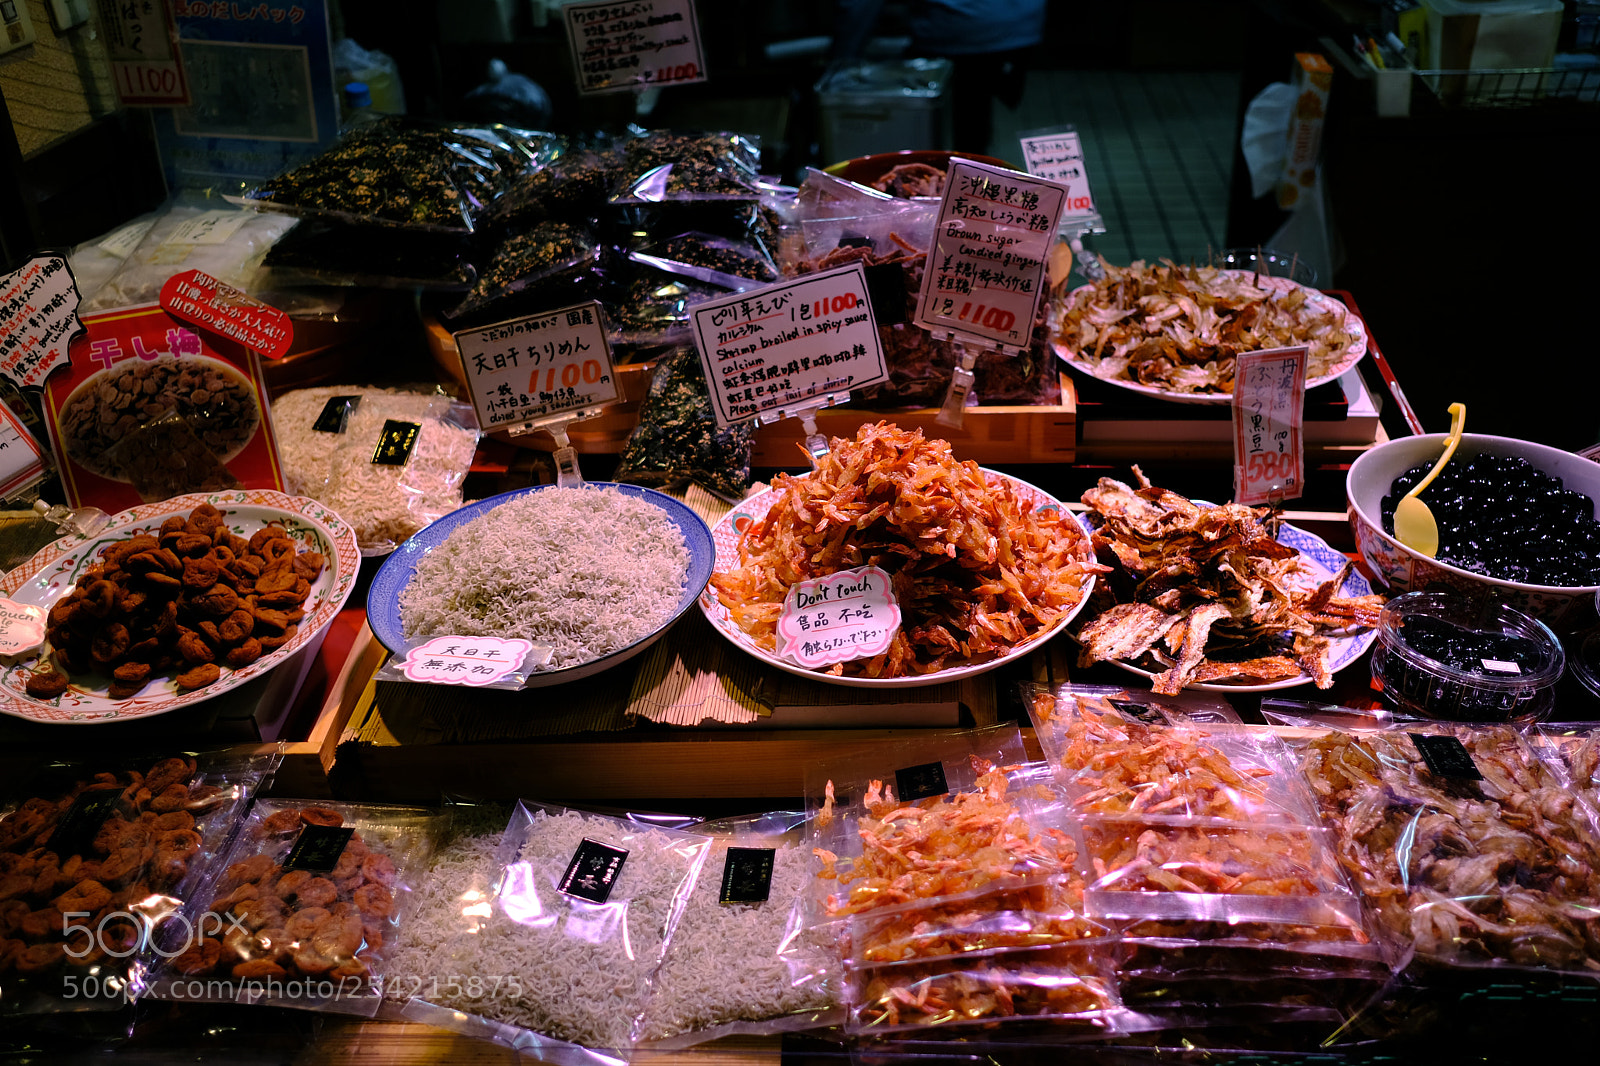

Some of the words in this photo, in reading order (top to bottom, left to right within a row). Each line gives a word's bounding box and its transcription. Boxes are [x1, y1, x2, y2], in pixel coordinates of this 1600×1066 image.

[124, 65, 176, 94] 1100
[986, 233, 1023, 250] sugar
[566, 309, 594, 325] 国産
[716, 343, 757, 361] Shrimp
[760, 327, 800, 348] broiled
[803, 326, 814, 337] in
[817, 318, 842, 333] spicy
[845, 313, 868, 326] sauce
[89, 327, 202, 370] 干し梅
[722, 357, 765, 375] calcium
[520, 405, 548, 419] young
[551, 396, 593, 411] sardines
[797, 584, 830, 609] Don't
[836, 575, 872, 599] touch
[441, 645, 501, 658] 天日干
[421, 659, 495, 675] 無添加
